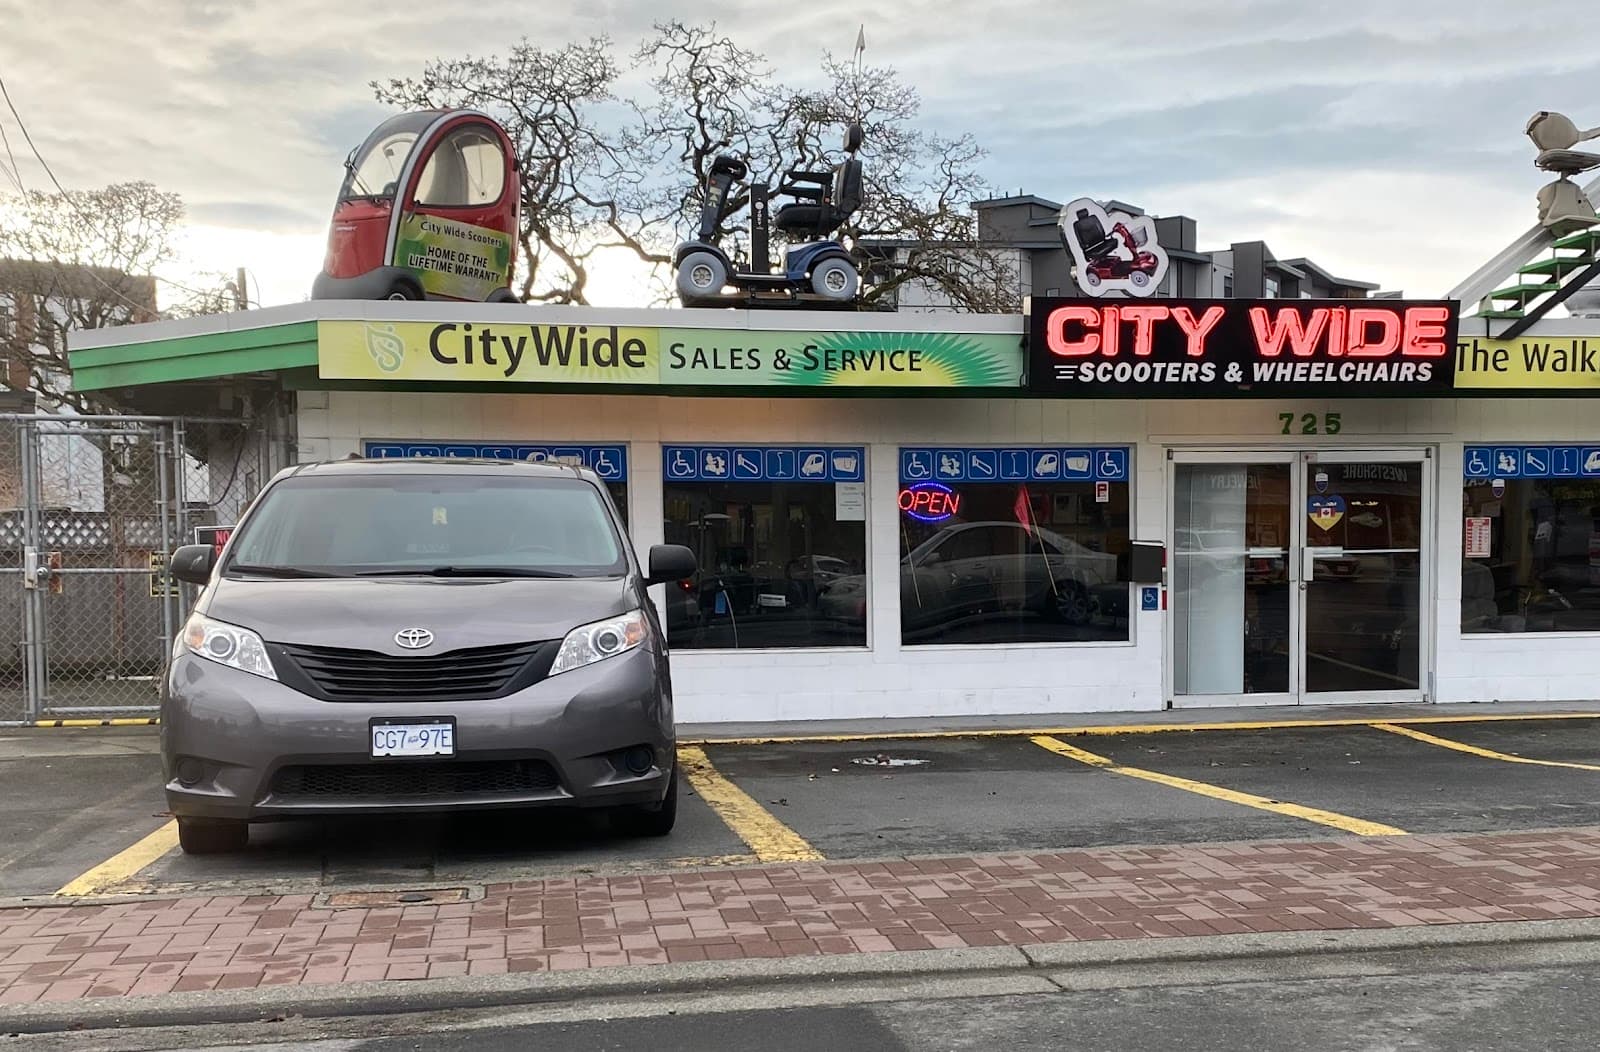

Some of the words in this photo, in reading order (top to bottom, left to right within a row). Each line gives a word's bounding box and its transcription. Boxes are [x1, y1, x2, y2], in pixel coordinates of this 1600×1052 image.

[420, 221, 441, 235] City
[443, 224, 465, 240] Wide
[468, 230, 502, 247] Scooters
[408, 254, 453, 274] LIFETIME
[454, 263, 501, 283] WARRANTY
[427, 246, 456, 261] HOME
[457, 252, 469, 265] OF
[472, 255, 488, 269] THE
[1046, 304, 1225, 357] CITY
[1248, 305, 1449, 357] WIDE
[428, 322, 647, 377] CityWide
[773, 349, 791, 370] &
[1456, 339, 1509, 372] The
[1522, 340, 1600, 373] Walk
[1078, 362, 1216, 383] SCOOTERS
[1224, 362, 1243, 384] &
[1252, 363, 1432, 383] WHEELCHAIRS
[1279, 413, 1341, 435] 725
[898, 490, 960, 514] OPEN
